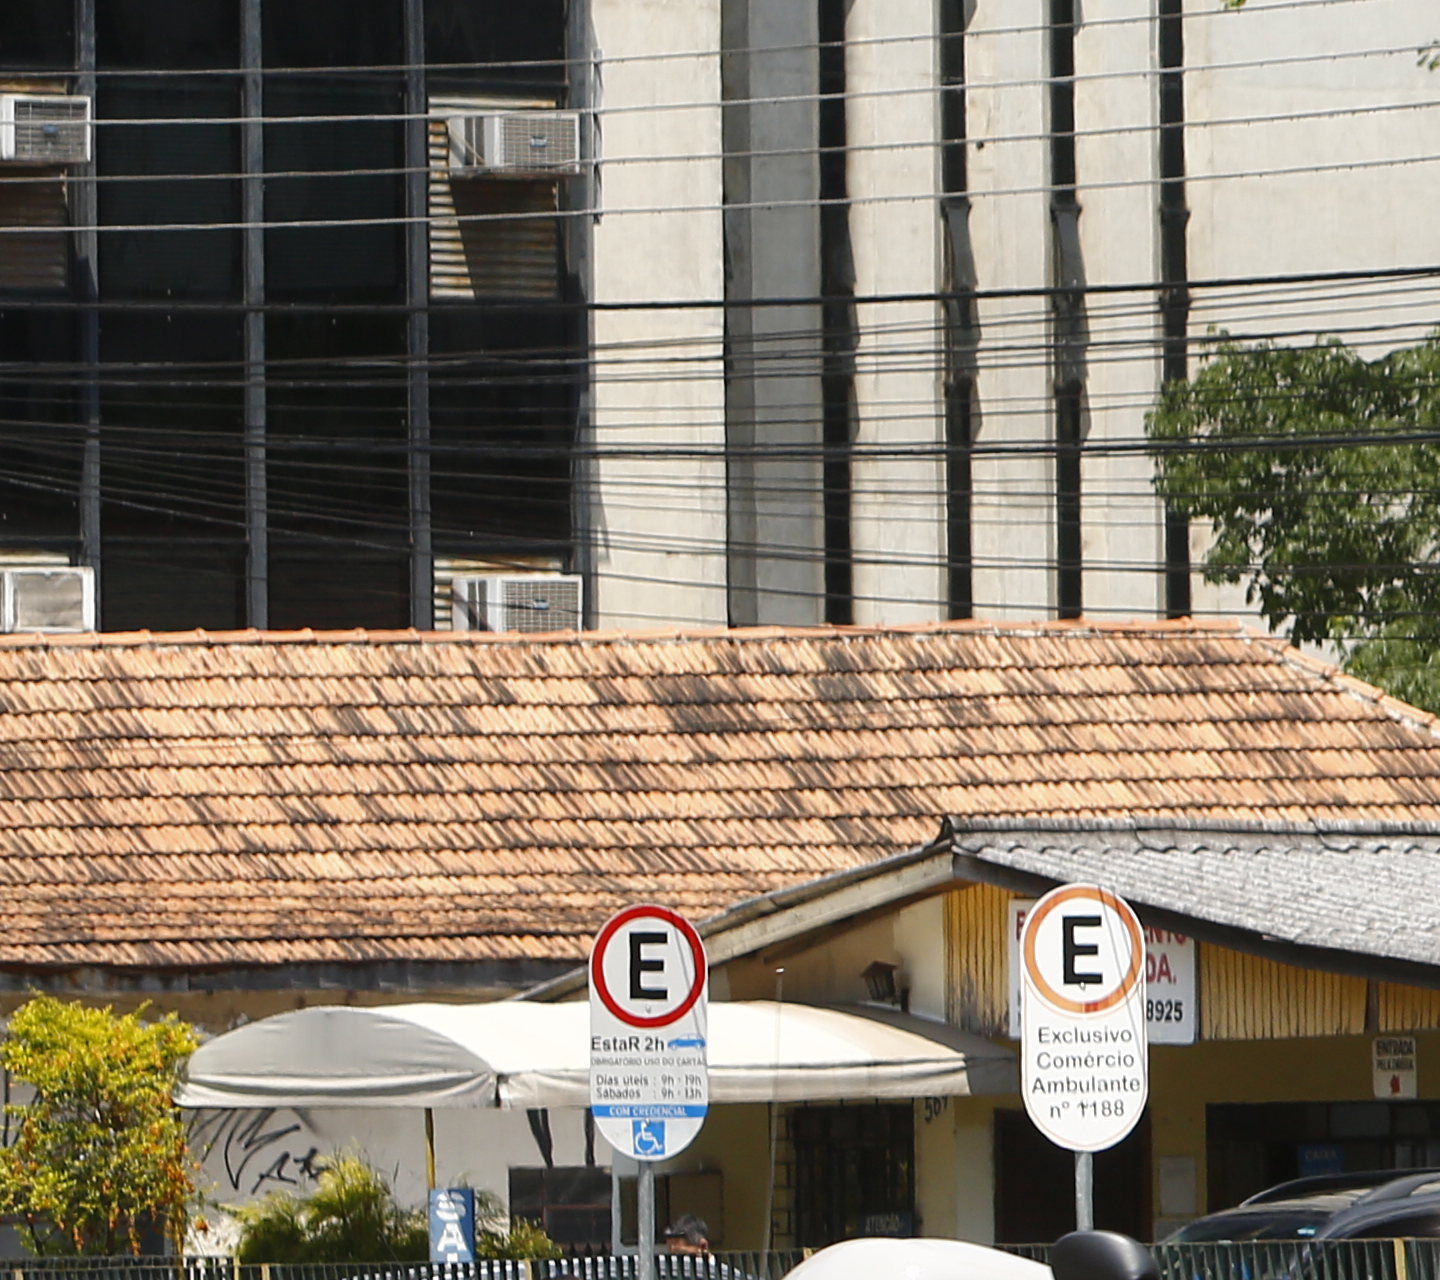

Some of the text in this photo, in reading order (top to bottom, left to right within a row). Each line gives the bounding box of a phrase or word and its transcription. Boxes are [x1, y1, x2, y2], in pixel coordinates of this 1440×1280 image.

[1062, 915, 1103, 985] E
[629, 931, 668, 1000] E
[591, 1036, 665, 1052] EstaR 2h
[1038, 1027, 1132, 1044] Exclusivo
[1036, 1050, 1135, 1069] Comércio
[596, 1074, 619, 1087] Dias
[660, 1075, 675, 1087] 9h
[684, 1074, 703, 1087] 19h
[1032, 1075, 1141, 1095] Ambulante
[660, 1087, 675, 1099] 9h
[684, 1087, 703, 1099] 13h
[609, 1106, 631, 1116] COM
[1077, 1099, 1125, 1118] 1188
